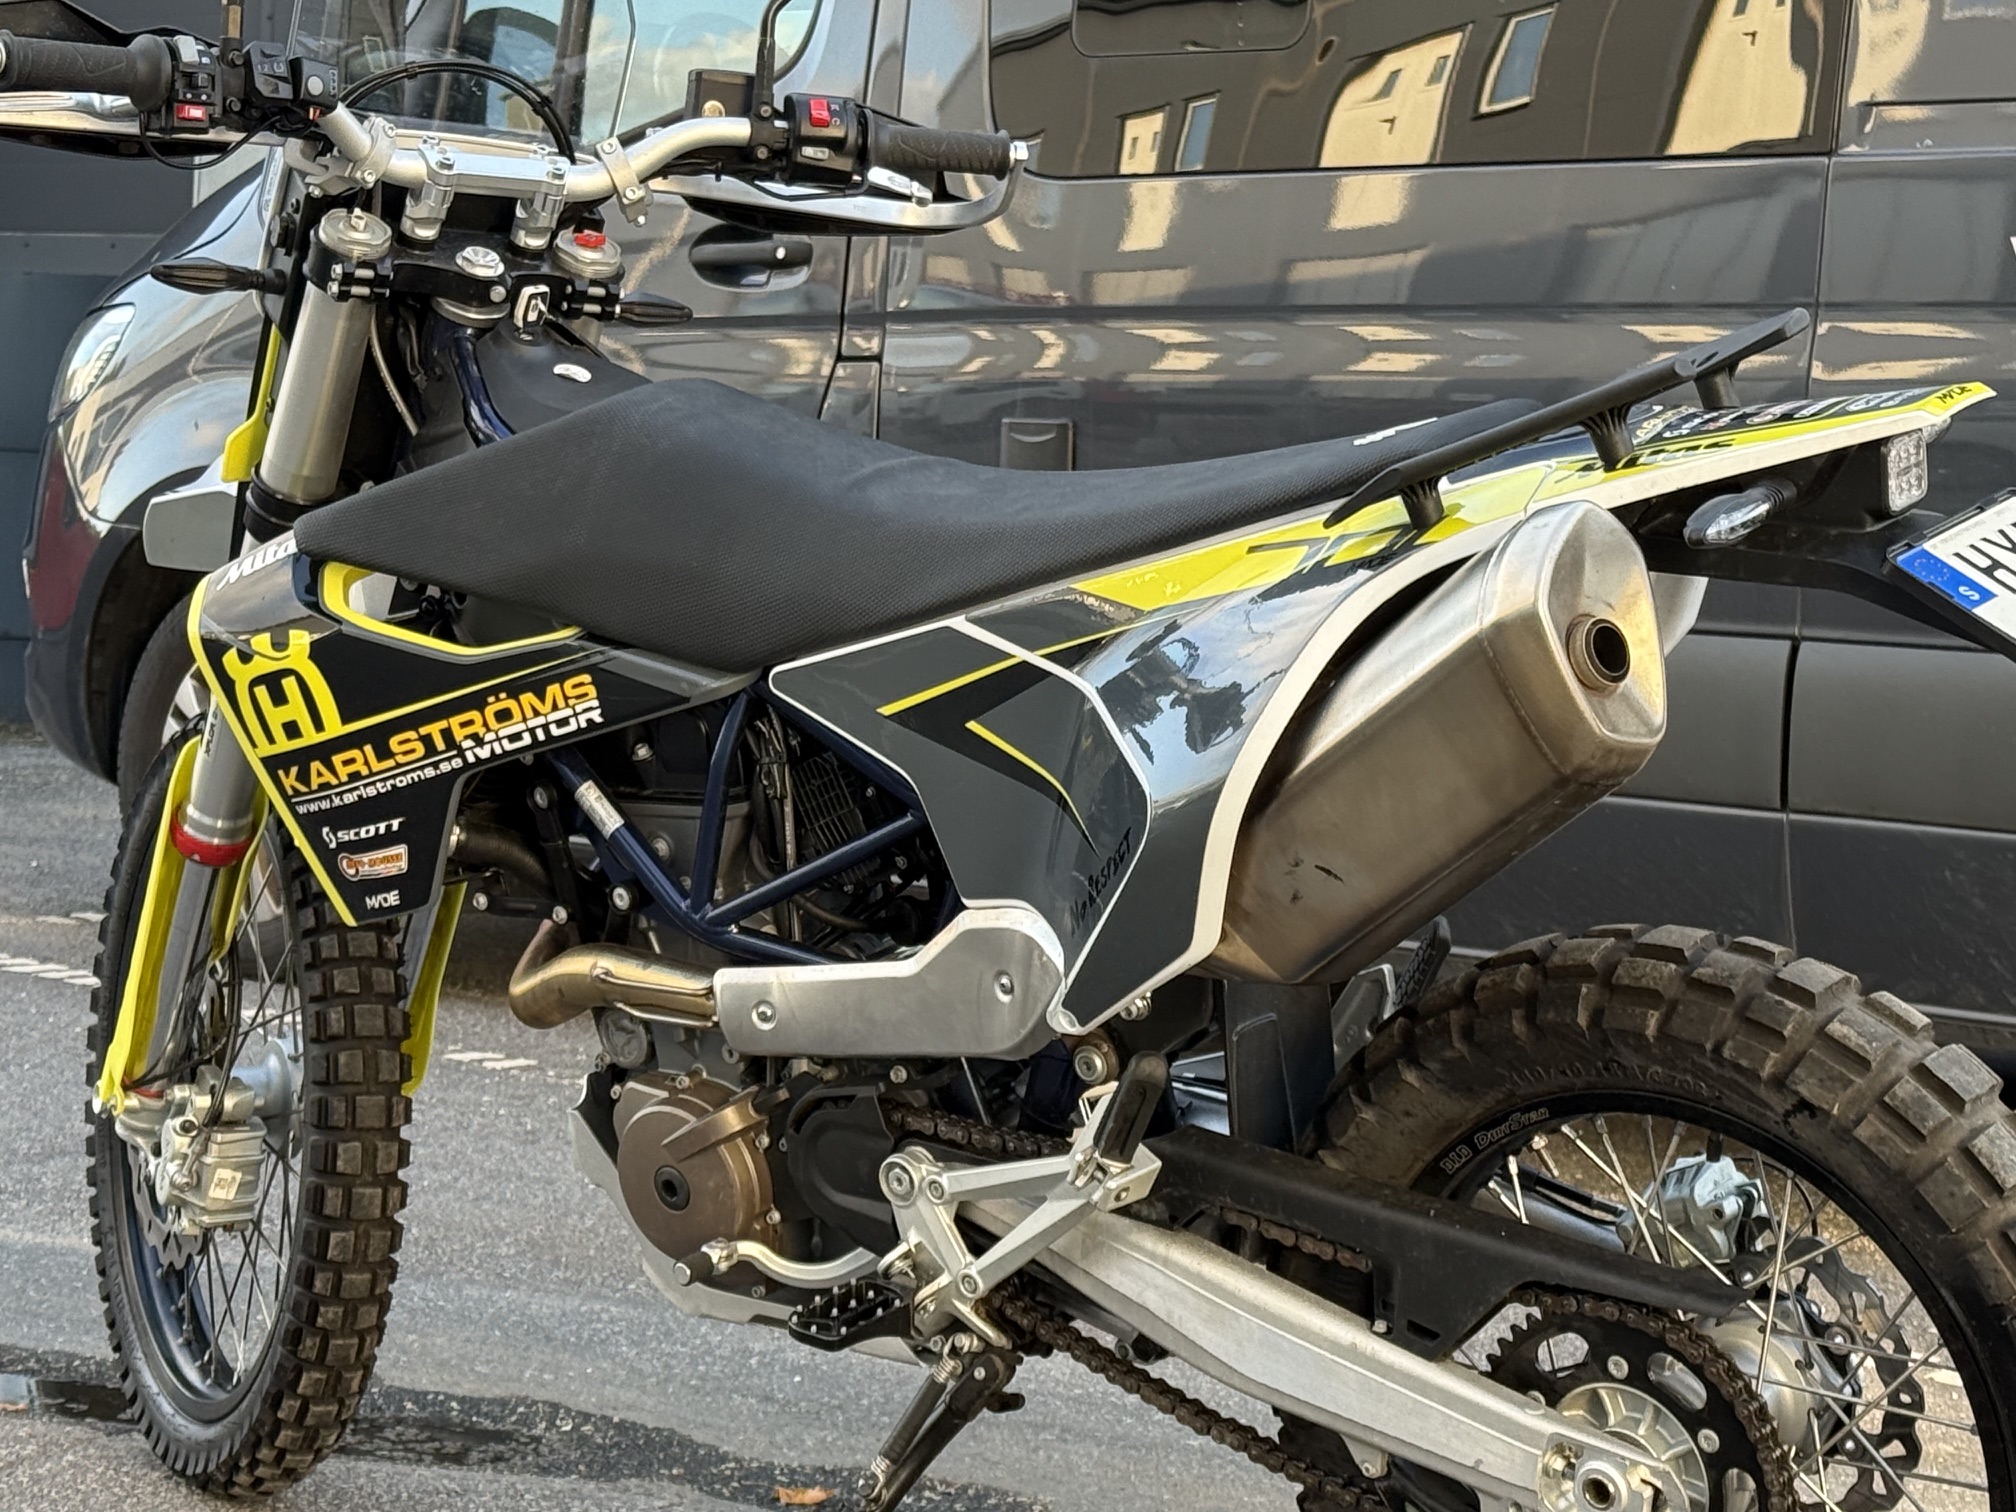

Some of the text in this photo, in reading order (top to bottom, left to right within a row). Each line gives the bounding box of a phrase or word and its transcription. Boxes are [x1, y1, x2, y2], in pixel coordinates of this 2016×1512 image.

[1952, 522, 2016, 595] HY
[1957, 584, 1981, 602] S
[277, 673, 597, 796] KARLSTRÖMS
[460, 698, 605, 764] MOTOR
[295, 756, 464, 815] www.karlstroms.se
[336, 816, 406, 843] SCOTT
